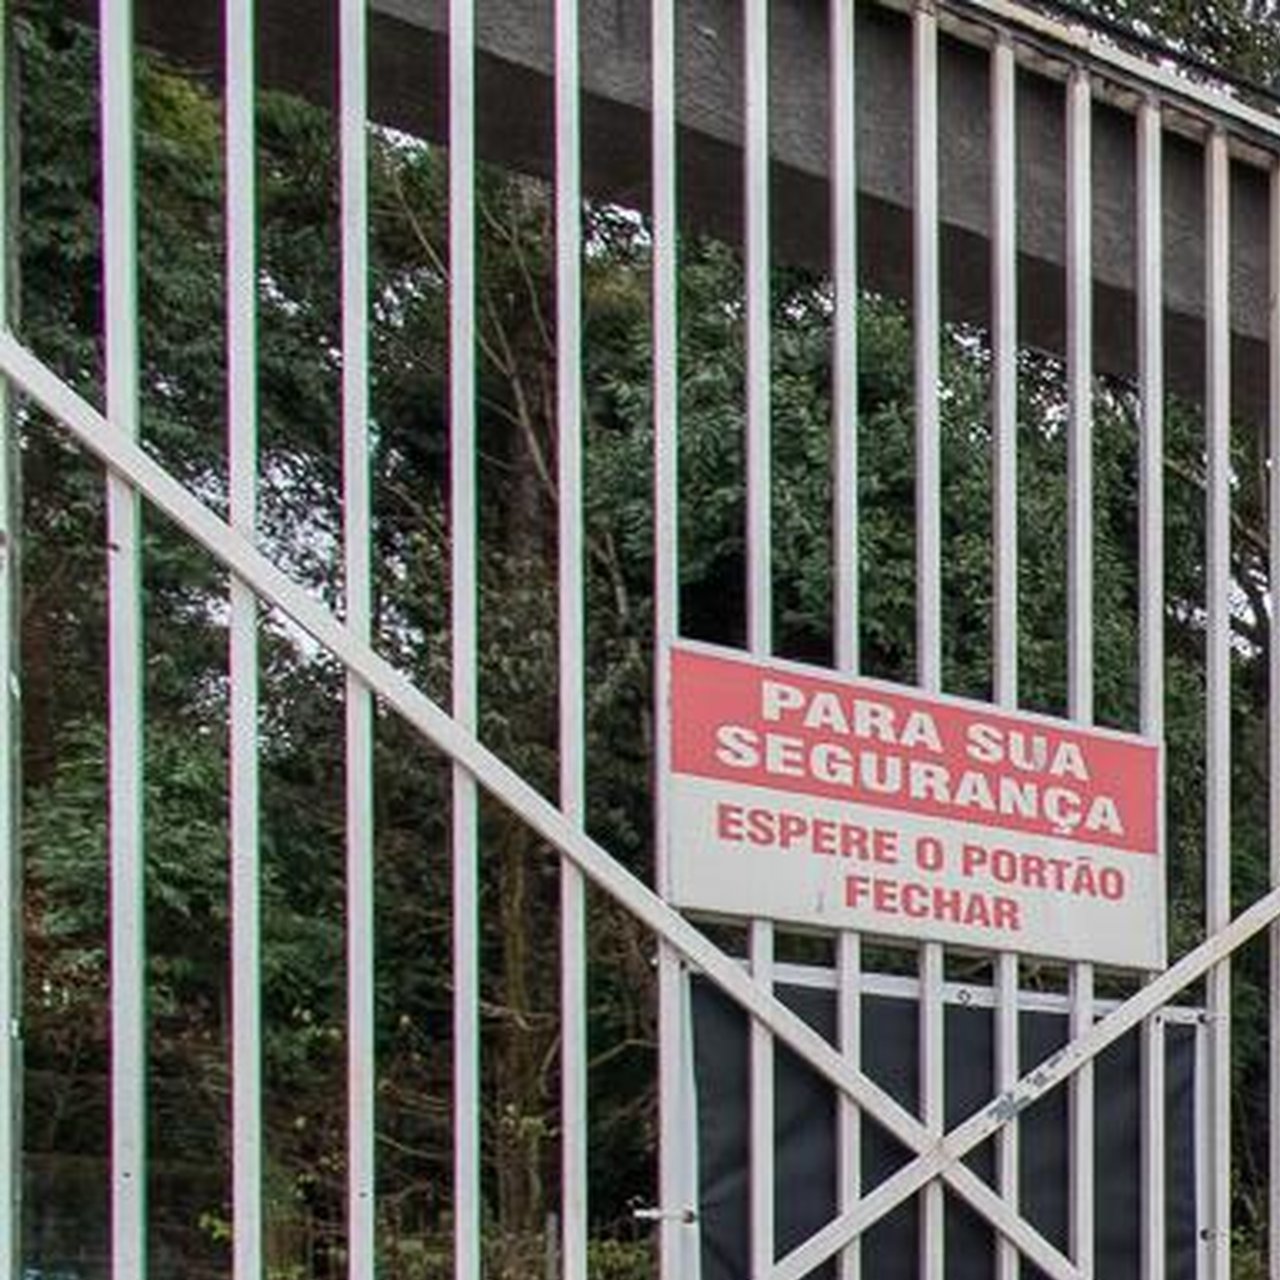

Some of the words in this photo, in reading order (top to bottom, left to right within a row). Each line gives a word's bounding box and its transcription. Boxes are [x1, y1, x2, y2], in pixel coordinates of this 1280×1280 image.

[760, 680, 943, 753] PARA
[966, 723, 1090, 781] SUA
[715, 725, 1125, 836] SEGURANÇA
[716, 803, 898, 864] ESPERE
[916, 837, 944, 871] O
[962, 843, 1125, 901] PORTÃO
[845, 877, 1022, 931] FECHAR
